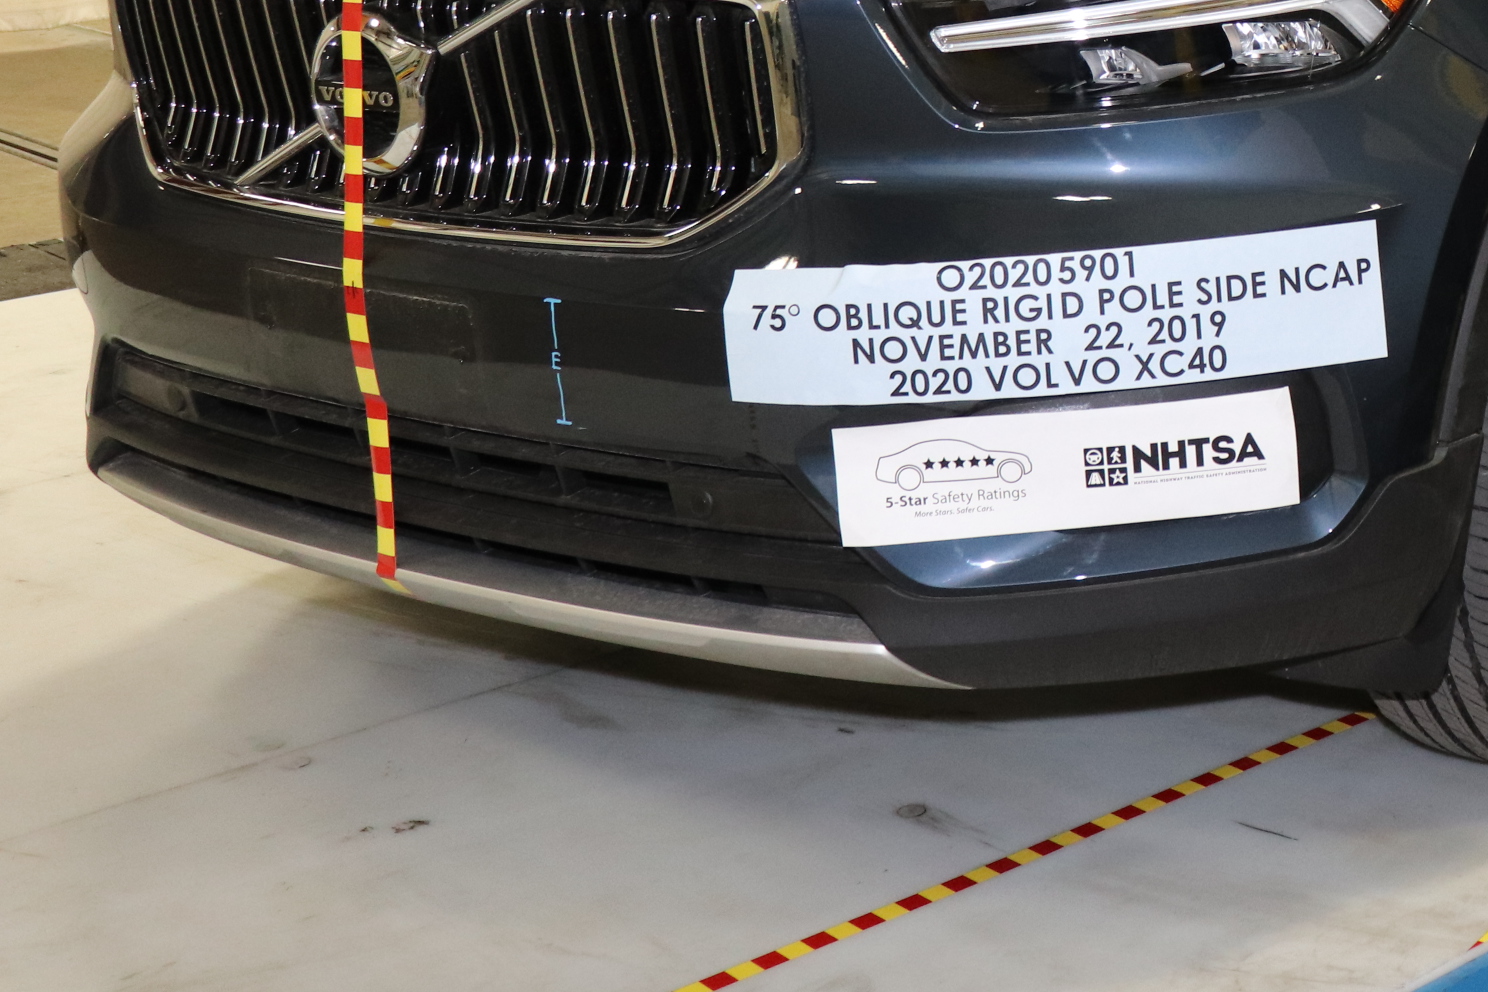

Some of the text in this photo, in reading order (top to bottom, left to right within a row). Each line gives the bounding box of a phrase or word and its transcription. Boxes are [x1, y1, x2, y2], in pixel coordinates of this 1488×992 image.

[318, 86, 394, 107] VOVO
[813, 298, 968, 331] OBLIQUE
[982, 291, 1084, 324] RIGID
[1098, 281, 1184, 316] POLE
[1196, 271, 1267, 305] SIDE
[1279, 258, 1372, 296] NCAP
[852, 310, 1227, 364] NOVEMBER 22, 2019
[552, 352, 561, 370] E
[889, 344, 1227, 397] 2020 VOLVO XC40
[1132, 432, 1266, 474] NHTSA
[1225, 468, 1267, 476] ADMINISTRATION
[885, 488, 1027, 508] 5-Star Safety Ratings
